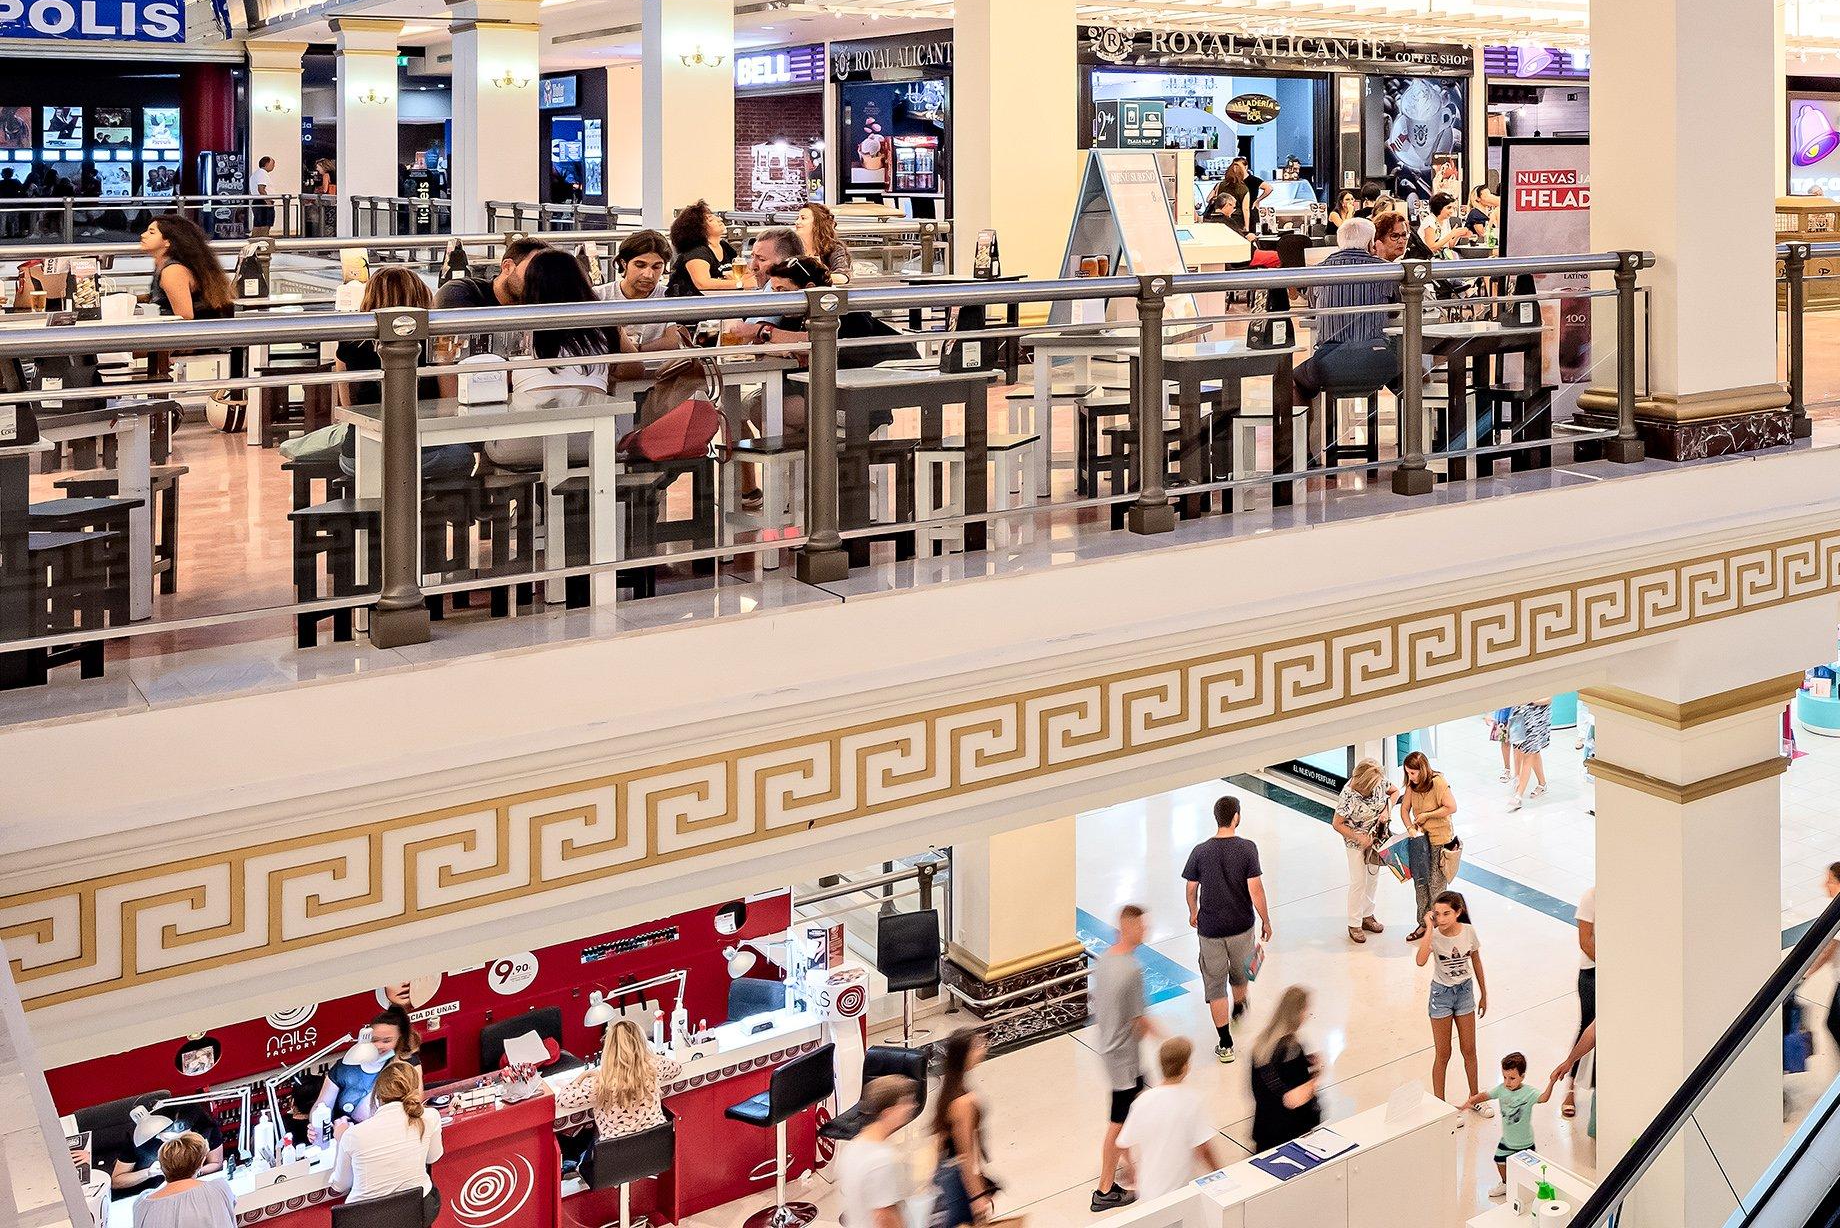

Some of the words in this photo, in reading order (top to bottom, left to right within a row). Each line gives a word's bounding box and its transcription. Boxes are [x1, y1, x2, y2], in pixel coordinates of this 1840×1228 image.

[1149, 31, 1244, 56] ROYAL
[1250, 33, 1387, 62] ALICANTE
[855, 47, 894, 71] ROYAL
[1395, 51, 1438, 65] COFFEE
[1439, 52, 1469, 66] SHOP
[737, 54, 791, 86] BELL
[1517, 172, 1576, 184] NUEVAS
[1520, 189, 1591, 208] HELAD
[1565, 314, 1587, 324] 100
[1298, 767, 1315, 778] NUEVO
[1315, 772, 1336, 787] PERFUME
[425, 1008, 435, 1017] DE
[266, 1026, 318, 1052] NAILS
[266, 1041, 318, 1059] FACTORY
